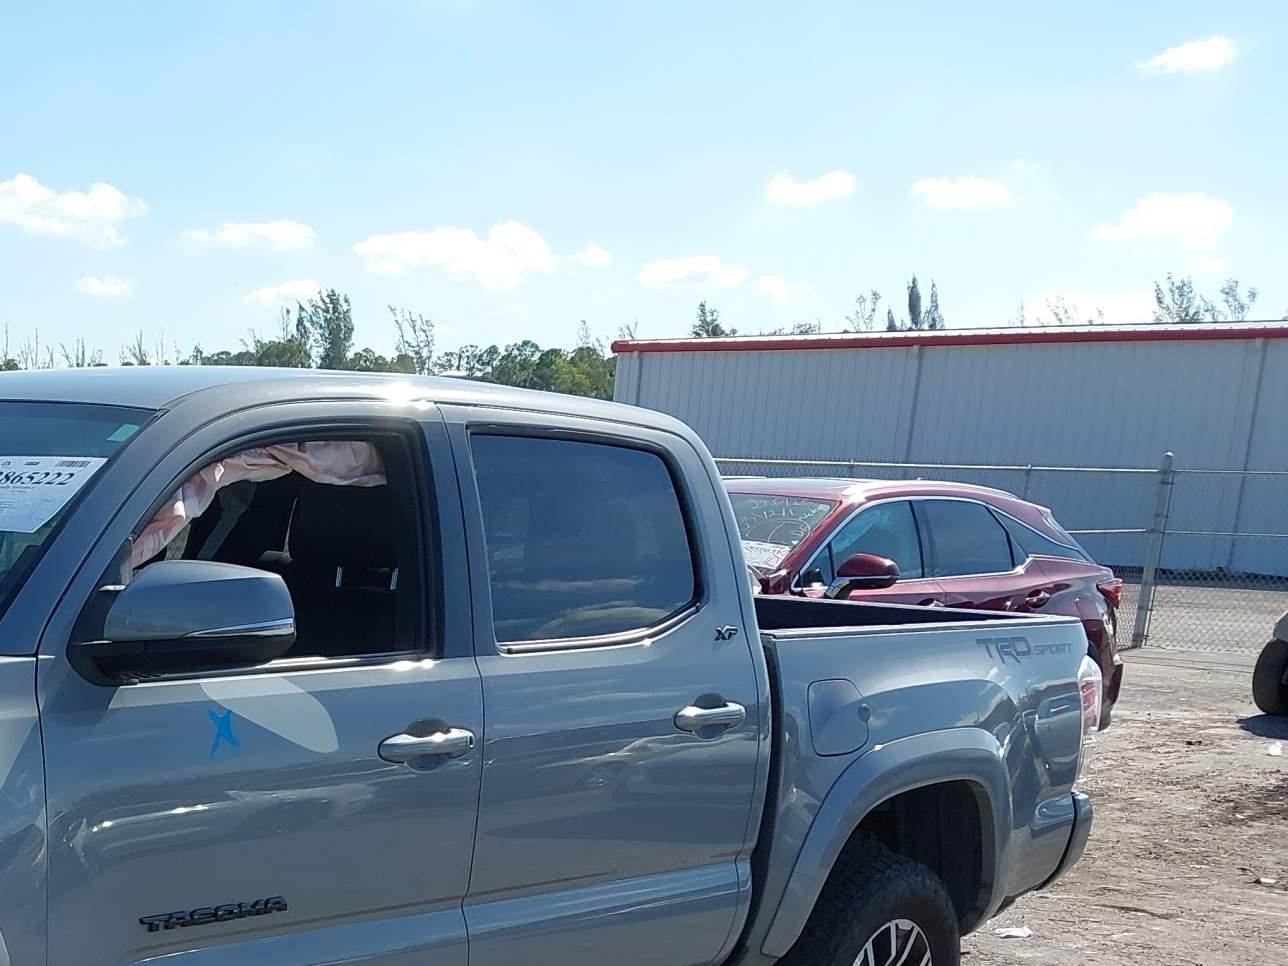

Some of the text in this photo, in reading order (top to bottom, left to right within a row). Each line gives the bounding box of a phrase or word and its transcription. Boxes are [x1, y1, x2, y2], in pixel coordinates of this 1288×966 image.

[976, 636, 1073, 664] TRD SPORT
[139, 895, 288, 932] TACOMA
